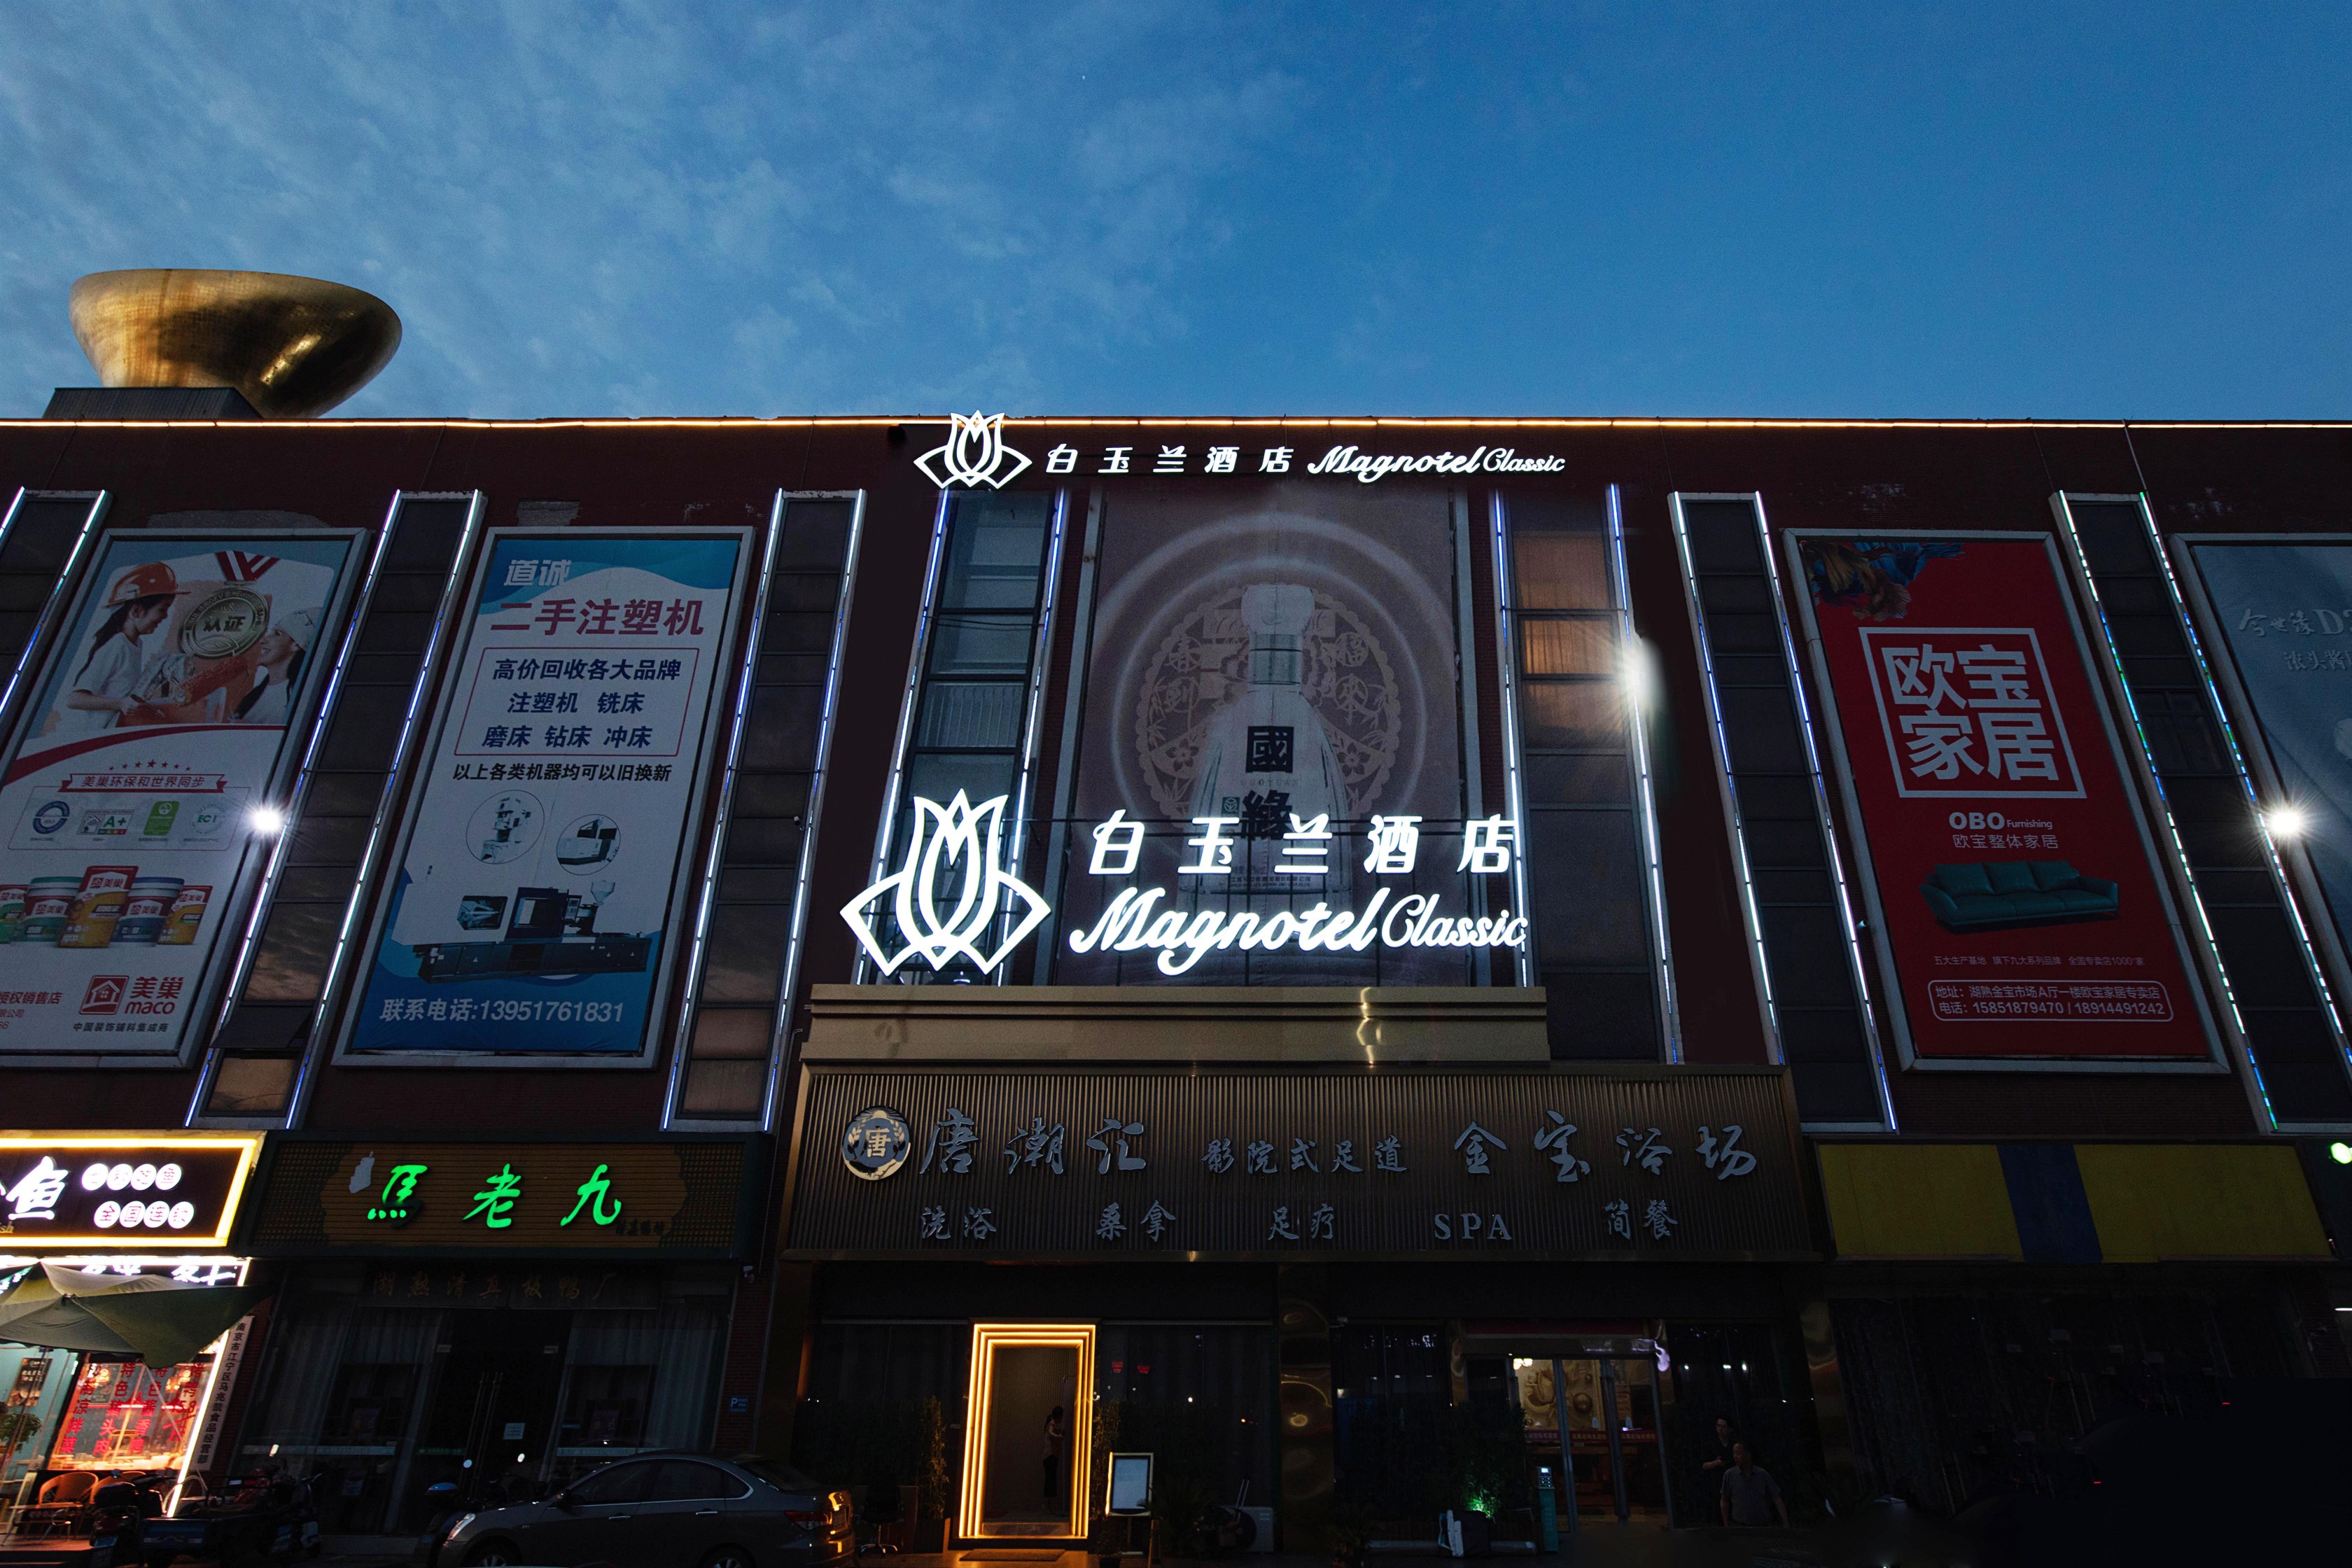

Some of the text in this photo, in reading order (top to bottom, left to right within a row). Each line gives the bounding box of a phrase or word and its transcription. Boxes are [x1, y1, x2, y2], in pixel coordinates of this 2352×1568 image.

[1045, 444, 1566, 482] 白玉兰酒店 Magnotel Classic
[503, 559, 571, 587] 道诚
[491, 598, 704, 636] 二手注塑机
[492, 659, 681, 680] 高价回收各大品牌
[1881, 643, 2042, 710] 欧宝
[506, 692, 645, 714] 注塑机 铣床
[482, 726, 652, 748] 磨床 钻床 冲床
[1898, 710, 2059, 780] 家居
[82, 776, 206, 788] 美巢环保和世界同步
[452, 764, 672, 782] 以上各类机器均可以旧换新
[1949, 812, 2053, 830] OBO Furnishing
[1088, 808, 1519, 875] 白玉兰酒店
[1953, 834, 2059, 849] 欧宝整体家居
[1069, 887, 1528, 976] Magnotel Classic
[1934, 956, 1987, 965] 五大生产基地
[1992, 956, 2062, 965] 旗下九大系列品牌
[0, 992, 63, 1004] 授权销售店
[130, 976, 184, 999] 美巢
[125, 1002, 175, 1014] maco
[2074, 1003, 2166, 1015] 18914491242
[865, 1127, 891, 1158] 唐
[919, 1107, 1146, 1175] 唐潮汇
[1201, 1136, 1407, 1174] 影院式足道
[1454, 1110, 1757, 1182] 金宝浴场
[0, 1155, 68, 1220] 鱼
[920, 1198, 1678, 1242] 洗浴 桑拿 足疗 SPA 简餐
